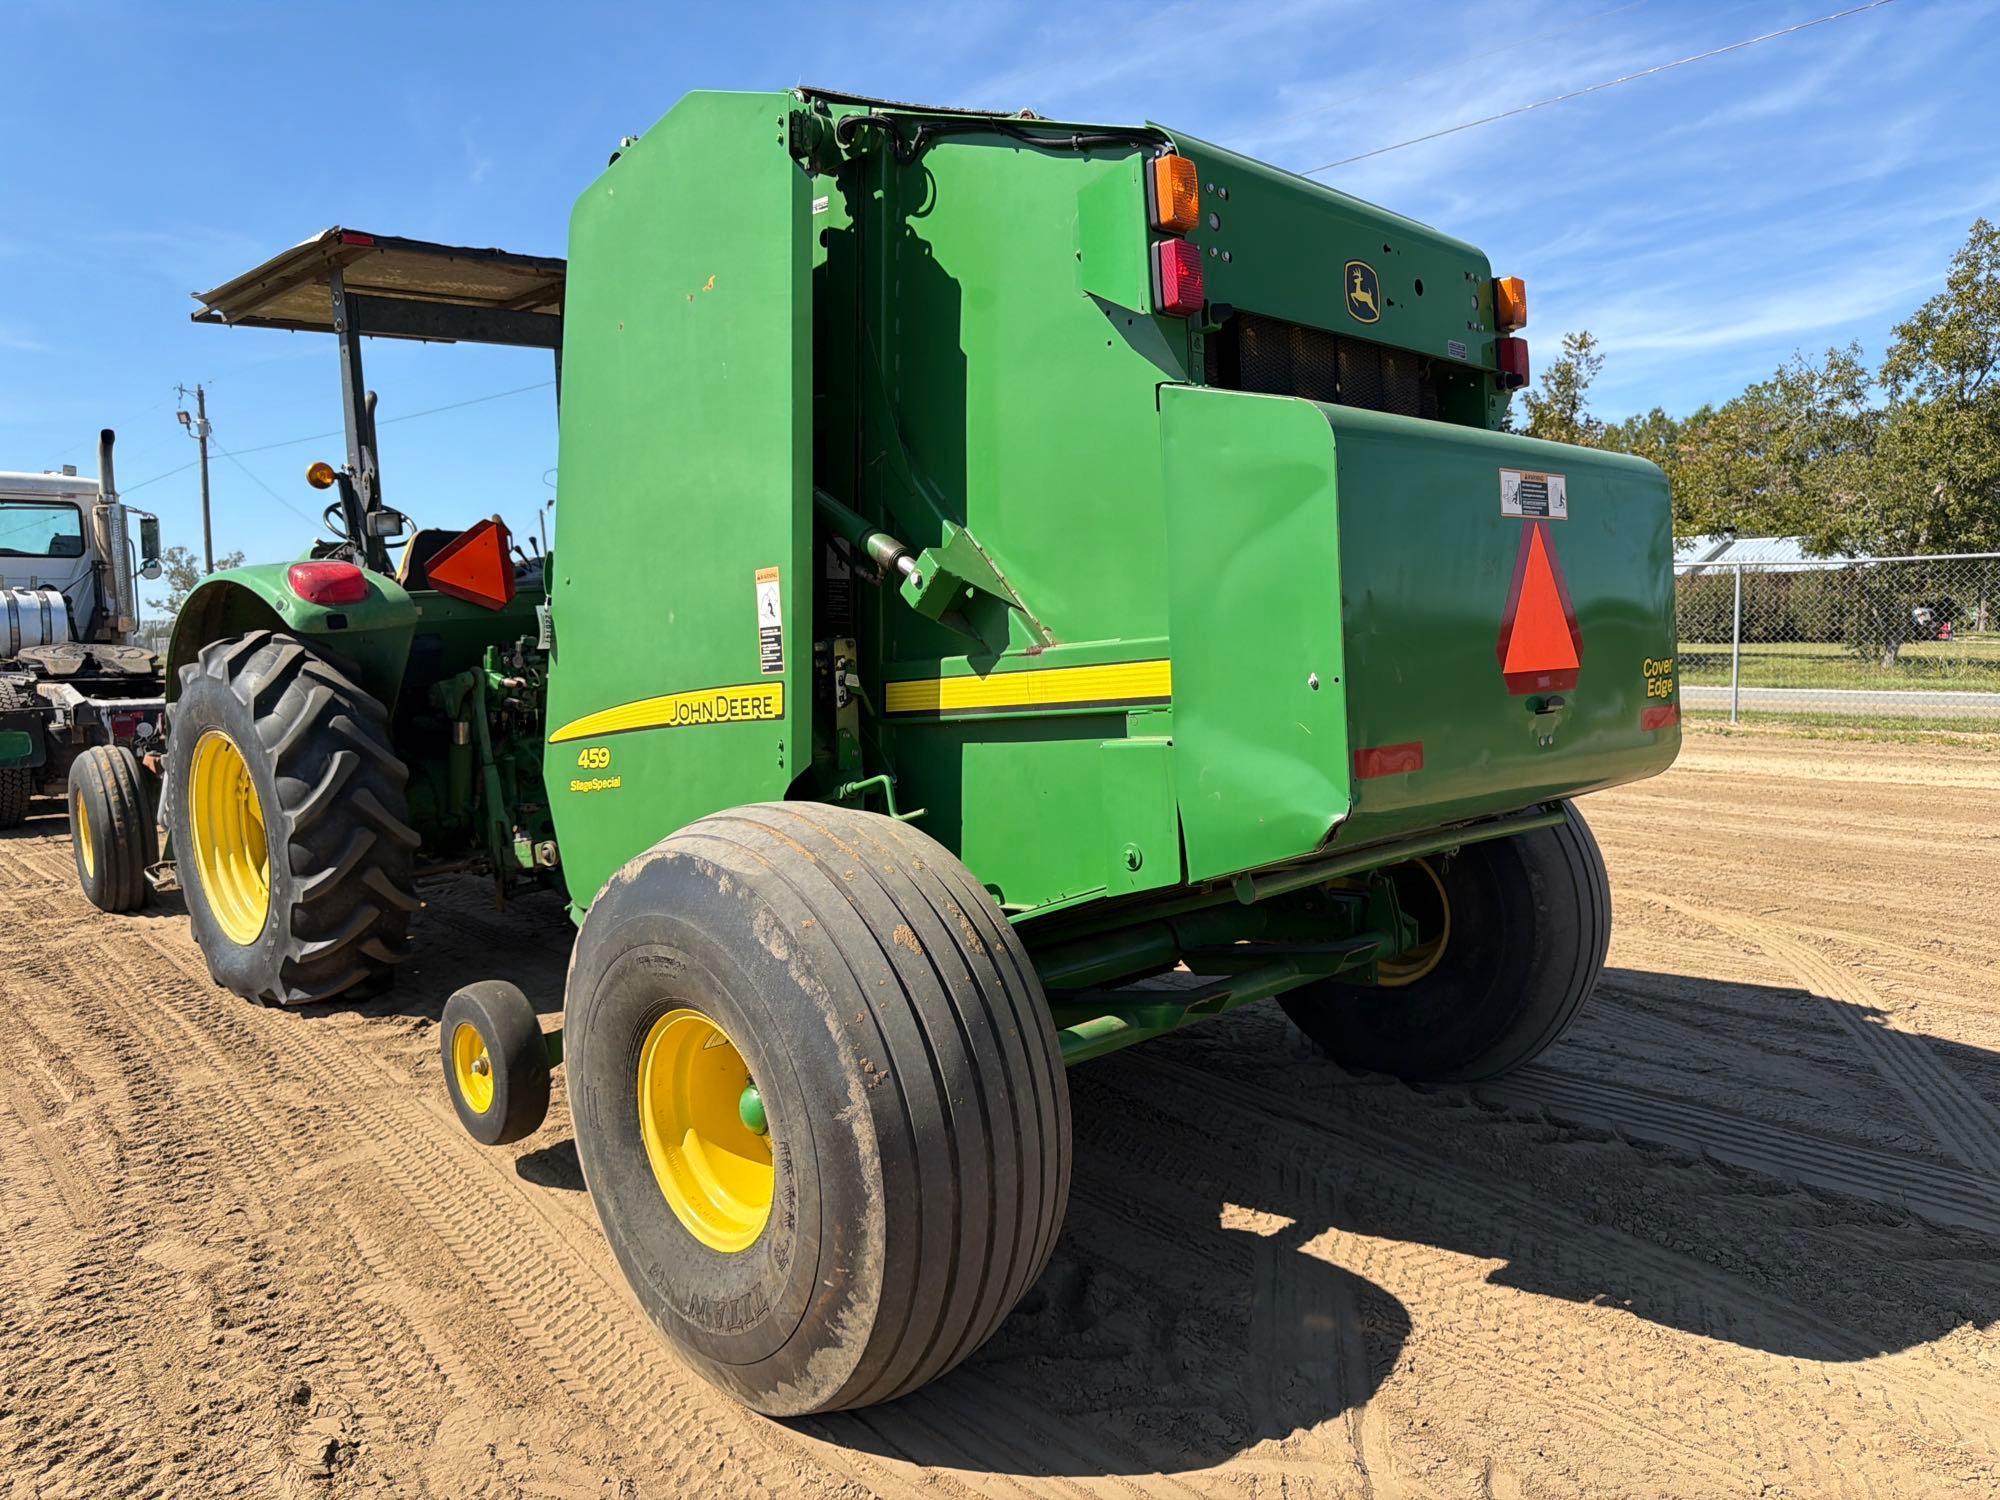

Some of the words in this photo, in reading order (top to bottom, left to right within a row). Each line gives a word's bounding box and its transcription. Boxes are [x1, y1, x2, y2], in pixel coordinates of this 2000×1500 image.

[1643, 657, 1673, 678] Cover
[1647, 677, 1673, 698] Edge
[670, 700, 713, 722] JOHN
[716, 695, 773, 718] DEERE
[577, 747, 611, 769] 459
[685, 1281, 769, 1331] TITAN
